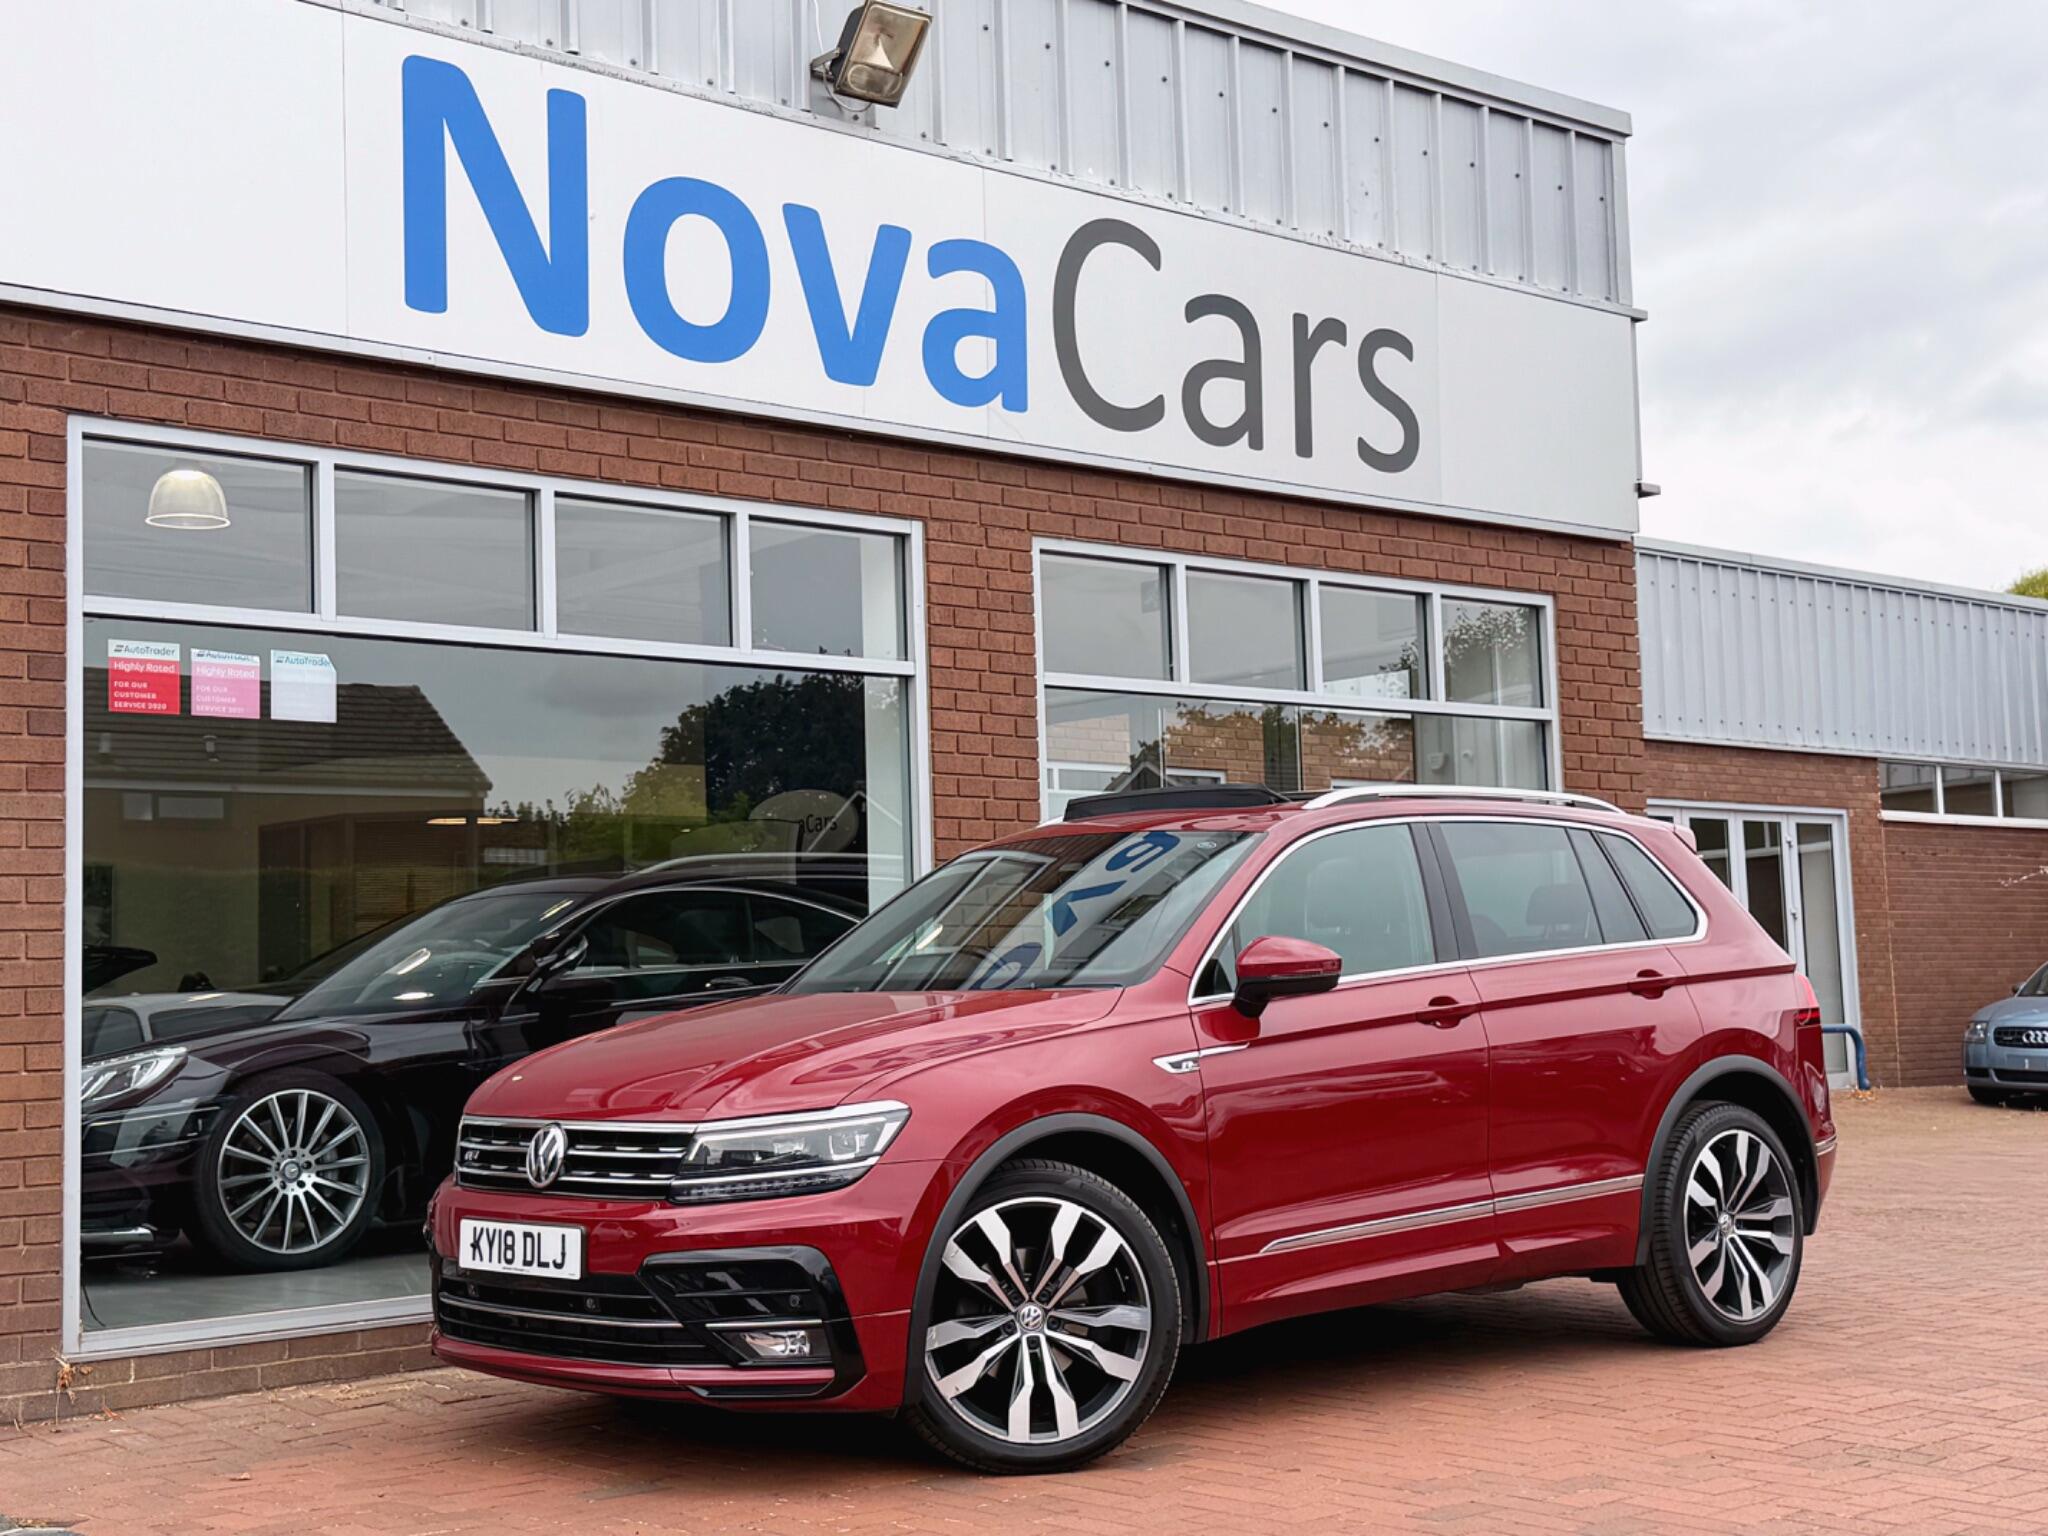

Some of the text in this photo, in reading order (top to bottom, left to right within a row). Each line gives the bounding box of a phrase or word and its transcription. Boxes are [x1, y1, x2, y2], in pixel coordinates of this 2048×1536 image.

[402, 54, 1420, 473] NovaCars
[124, 645, 176, 656] AutoTrader
[114, 661, 176, 673] Highly Rated
[196, 666, 225, 678] Highly
[113, 691, 157, 699] CUSTOMER
[114, 701, 146, 709] SERVICE
[470, 1226, 566, 1270] KY18 DLJ
